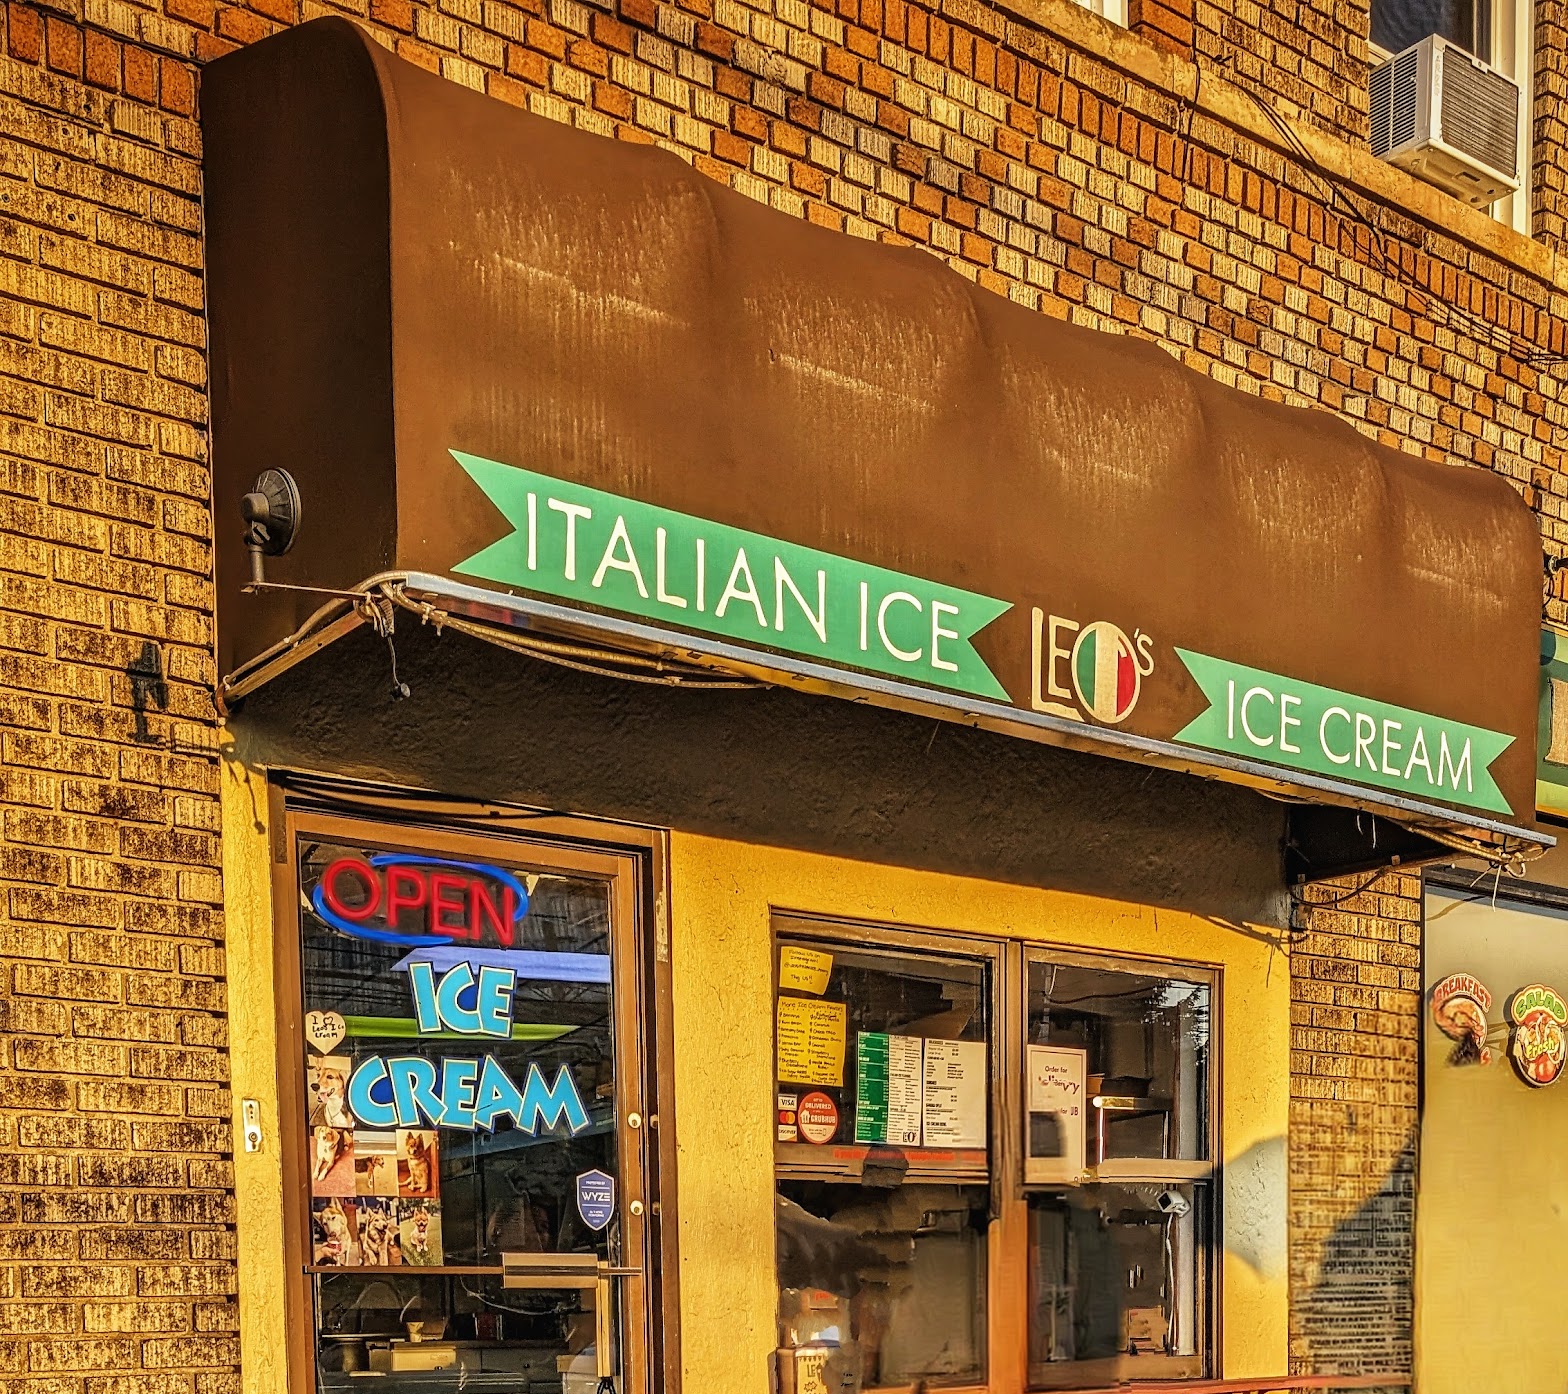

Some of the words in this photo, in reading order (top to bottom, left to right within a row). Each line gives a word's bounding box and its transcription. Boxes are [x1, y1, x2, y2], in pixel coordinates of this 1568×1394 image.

[526, 492, 827, 644] ITALIAN
[858, 581, 960, 673] ICE
[1030, 606, 1155, 724] LEO'S
[1226, 680, 1302, 754] ICE
[1318, 706, 1473, 793] CREAM
[321, 857, 517, 946] OPEN
[407, 960, 518, 1039] ICE
[1434, 975, 1492, 1012] BREAKFAST
[1516, 990, 1566, 1021] SALAD
[1526, 1037, 1556, 1060] Fresh
[347, 1053, 592, 1138] CREAM
[804, 1102, 832, 1110] DELIVERED
[810, 1115, 836, 1124] GRUBHUB
[581, 1191, 611, 1202] WYZE
